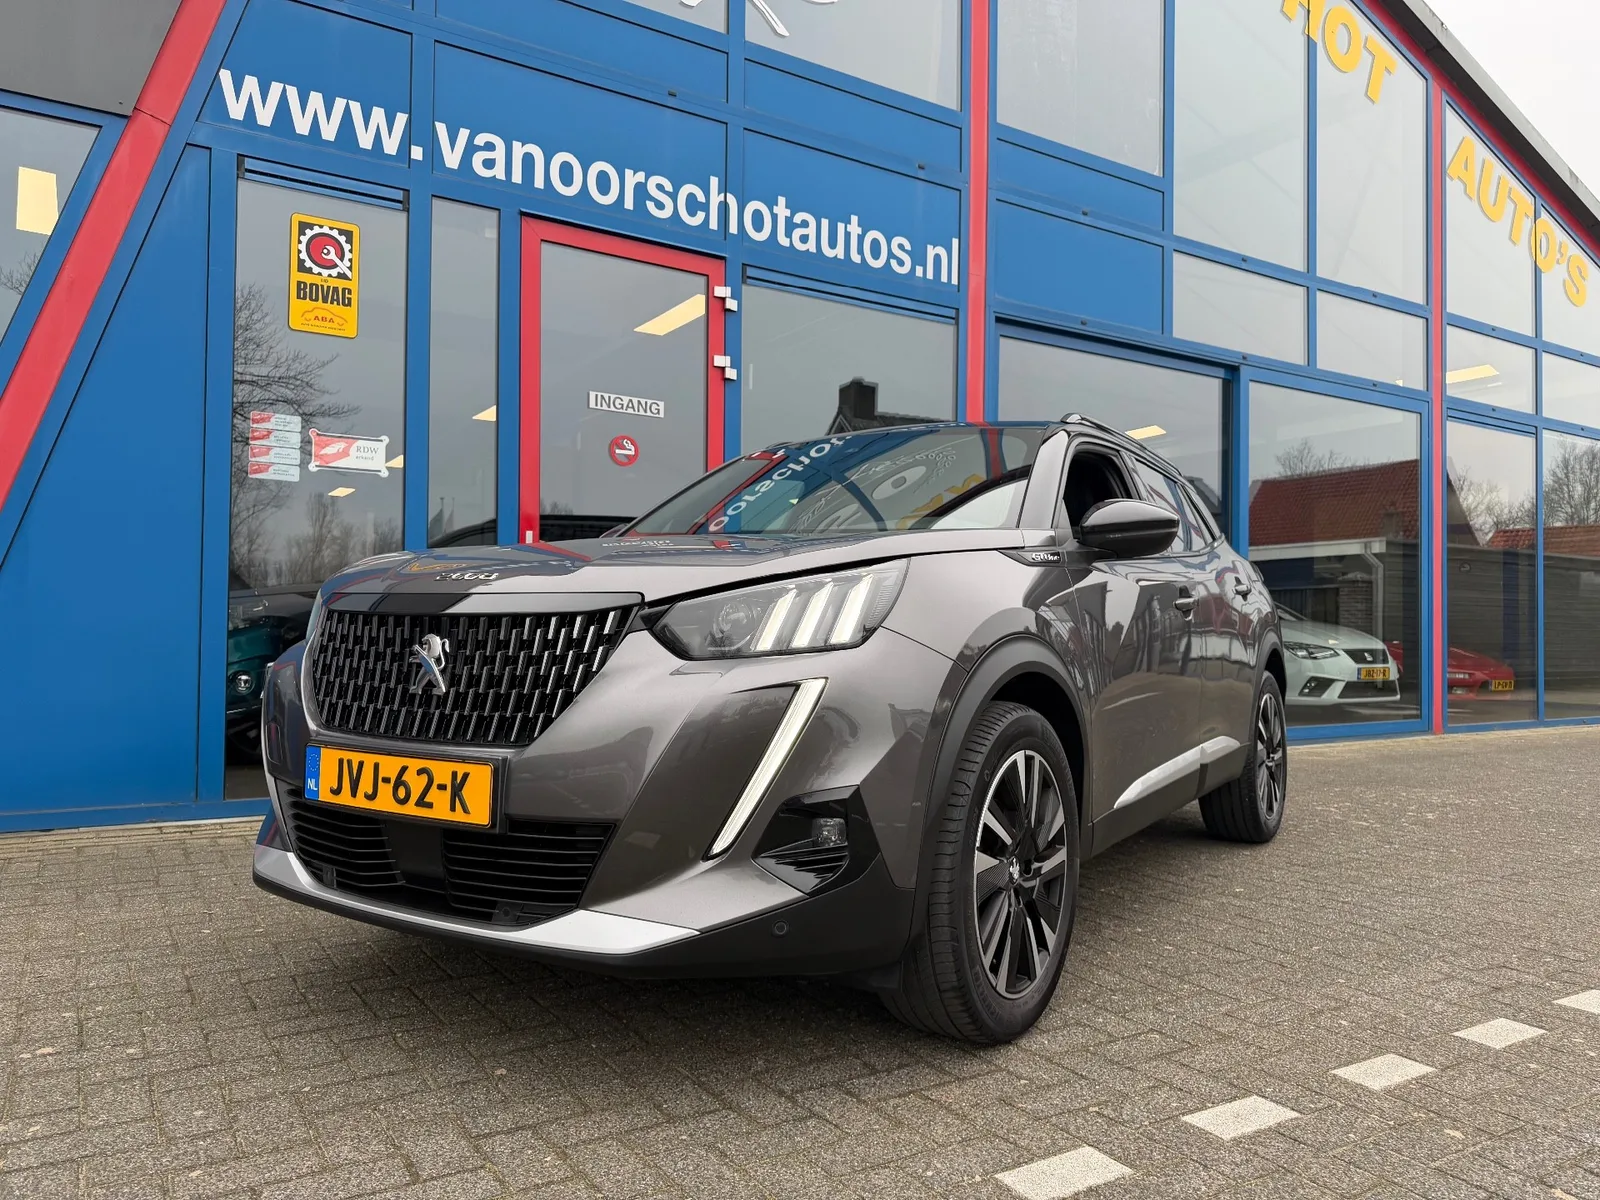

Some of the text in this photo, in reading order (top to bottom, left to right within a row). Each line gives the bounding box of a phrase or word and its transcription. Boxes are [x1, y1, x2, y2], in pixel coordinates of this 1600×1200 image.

[218, 68, 959, 286] www.vanoorschotautos.nl
[1446, 136, 1589, 307] AUTO'S
[296, 280, 352, 307] BOVAG
[313, 315, 335, 324] ABA
[594, 393, 661, 415] INGANG
[356, 445, 379, 454] RDW
[307, 777, 318, 791] NL
[329, 757, 471, 815] JVJ-62-K
